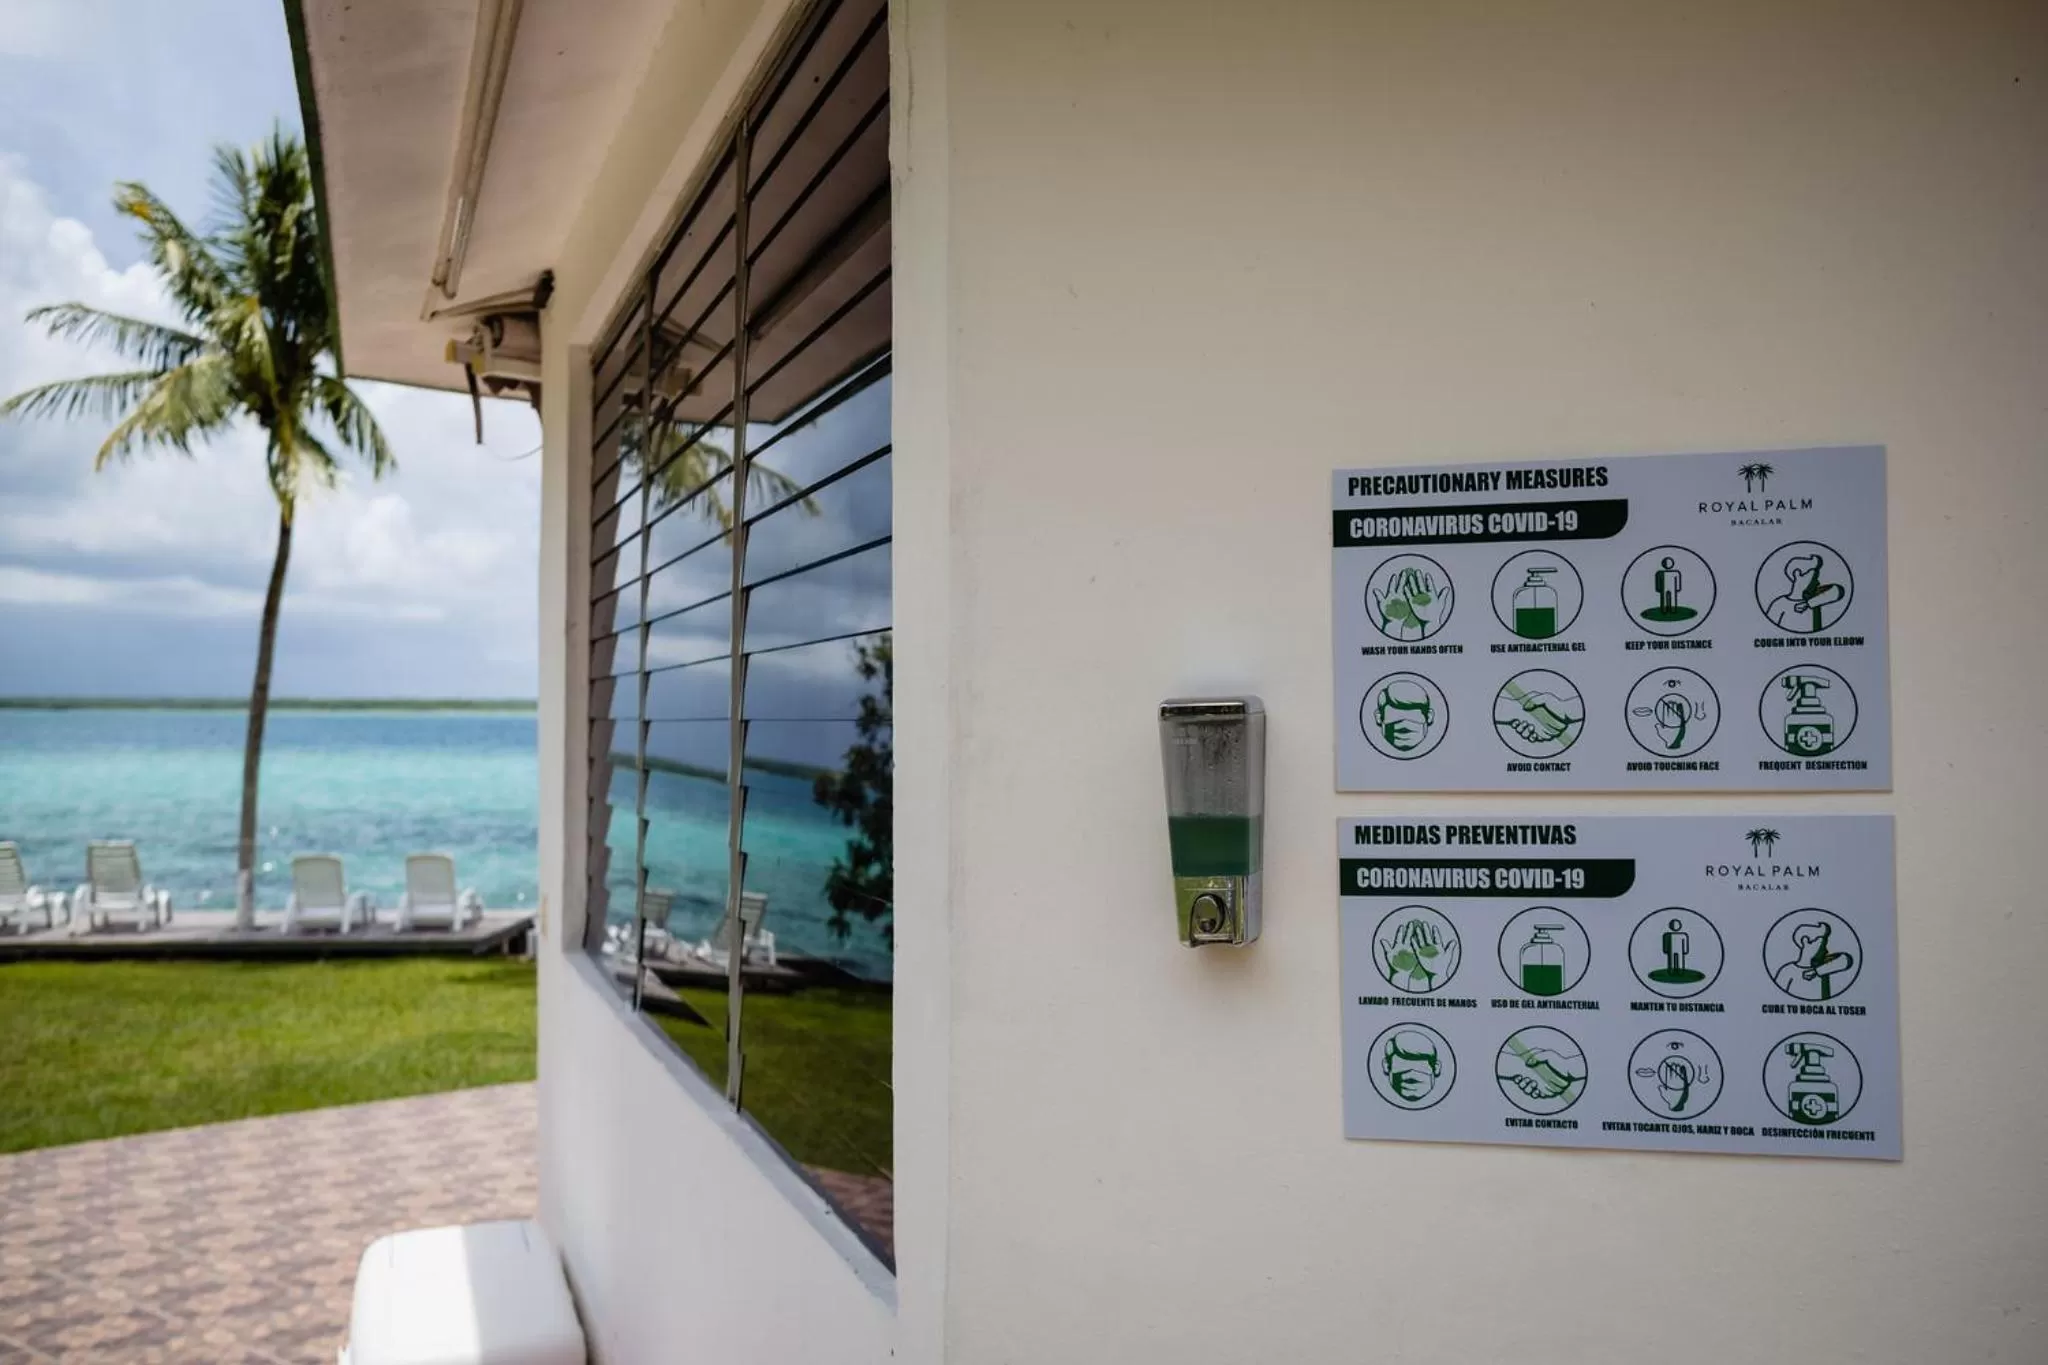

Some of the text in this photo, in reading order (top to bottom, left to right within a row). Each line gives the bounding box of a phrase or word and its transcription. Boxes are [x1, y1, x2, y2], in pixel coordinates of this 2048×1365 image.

[1348, 466, 1609, 496] PRECAUTIONARY MEASURES
[1698, 498, 1813, 514] ROYAL PALM
[1349, 509, 1579, 539] CORONAVIRUS COVID-19
[1730, 518, 1782, 527] BACALAR
[1490, 642, 1586, 653] USE ANTIBACTERIAL GEL
[1625, 639, 1713, 650] KEEP YOUR DISTANCE
[1754, 636, 1865, 648] COUGH INTO YOUR ELBOW
[1361, 644, 1464, 656] WASH YOUR HANDS OFTEN
[1506, 762, 1571, 772] AVOID CONTACT
[1627, 761, 1720, 771] AVOID TOUCHING FACE
[1759, 760, 1868, 772] FREQUENT DESINFECTION
[1355, 825, 1577, 845] MEDIDAS PREVENTIVAS
[1706, 865, 1820, 877] ROYAL PALM
[1356, 867, 1585, 889] CORONAVIRUS COVID-19
[1737, 884, 1790, 892] BACALAR
[1358, 996, 1477, 1008] LAVADO FRECUENTE DE MANOS
[1491, 999, 1600, 1010] USO DE GEL ANTIBACTERIAL
[1665, 1002, 1678, 1011] TU
[1678, 1003, 1725, 1012] DISTANCIA
[1761, 1004, 1867, 1016] CUBE TU BOCA AL TOSER
[1505, 1117, 1579, 1129] EVITAR CONTACTO
[1602, 1121, 1631, 1131] EVITAR
[1671, 1124, 1695, 1135] OJOS,
[1696, 1125, 1721, 1135] NARIZ
[1722, 1126, 1729, 1135] Y
[1730, 1126, 1755, 1136] BOCA
[1826, 1130, 1875, 1141] FRECUENTE
